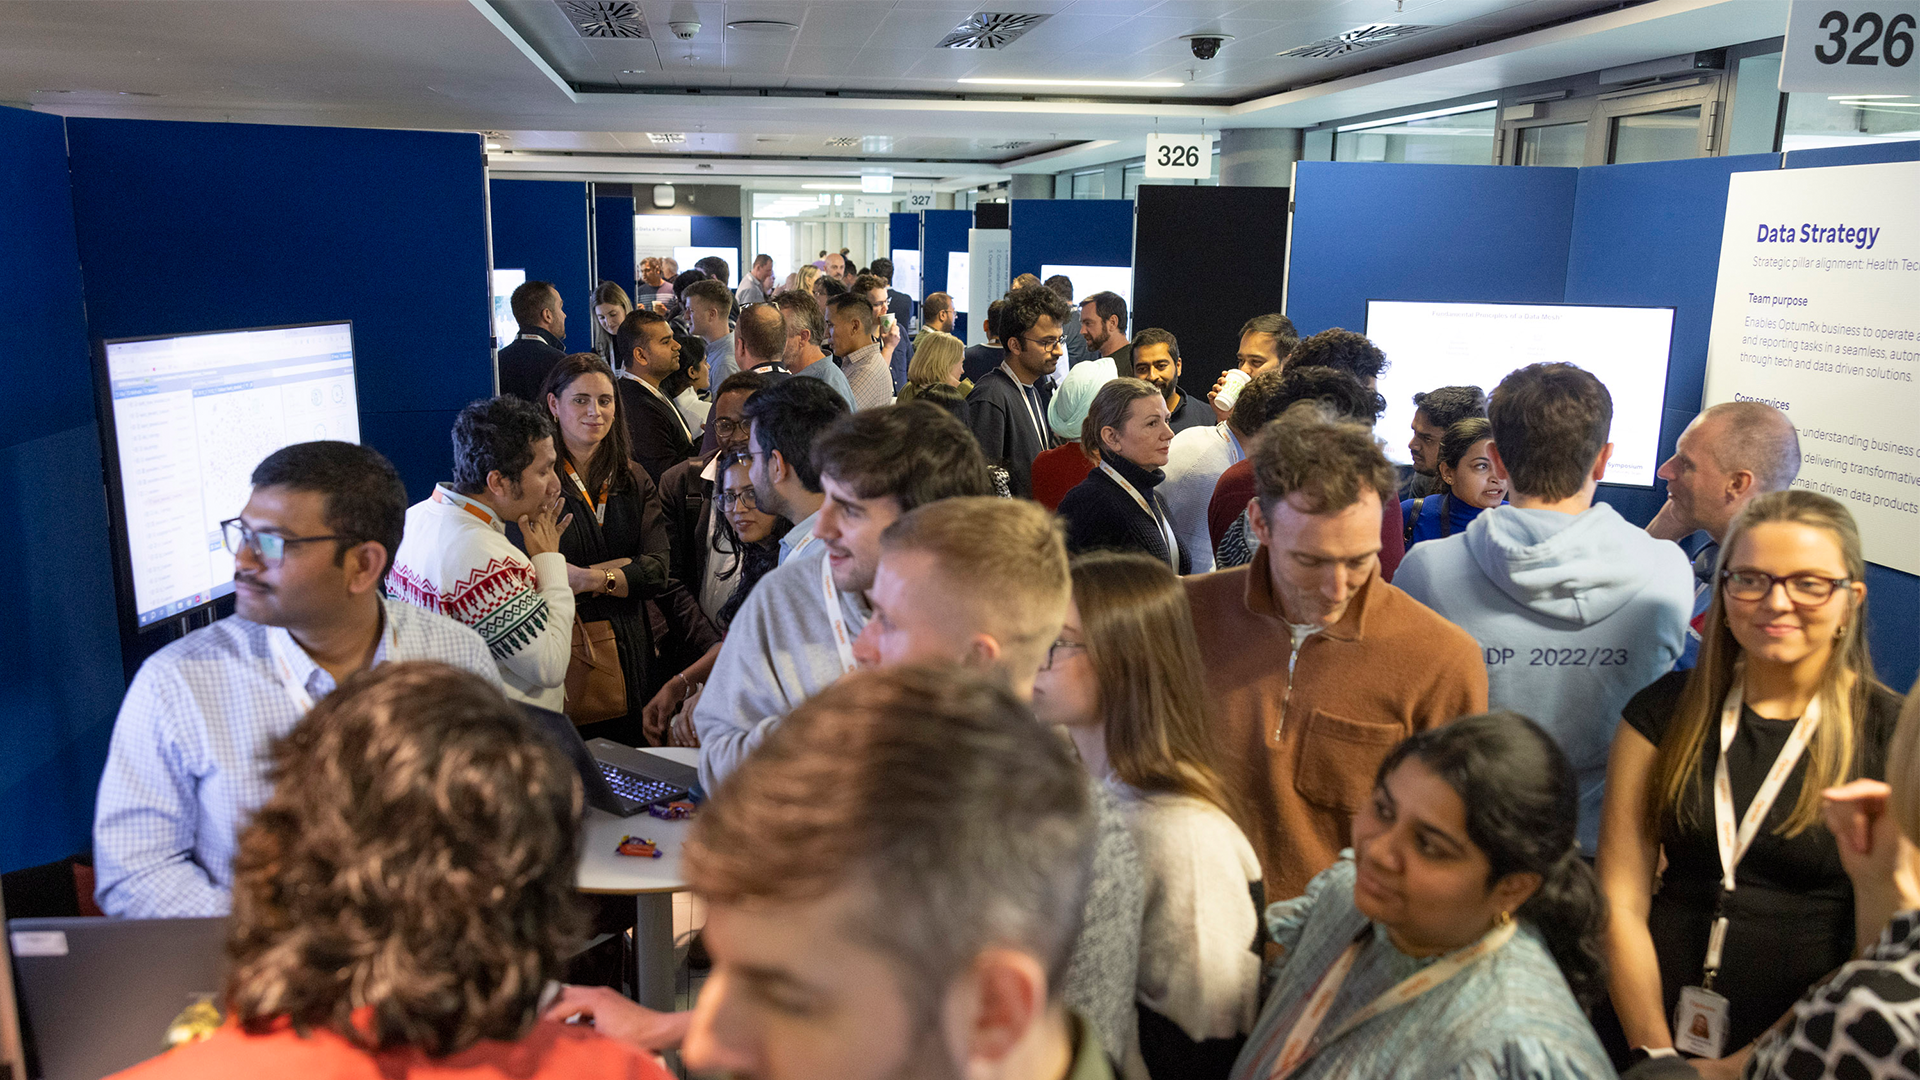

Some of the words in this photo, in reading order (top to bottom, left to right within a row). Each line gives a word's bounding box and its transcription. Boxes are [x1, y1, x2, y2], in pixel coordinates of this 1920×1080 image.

[1814, 10, 1917, 67] 326
[1157, 145, 1199, 167] 326
[911, 195, 931, 206] 327
[1757, 224, 1796, 243] Data
[1799, 223, 1880, 250] Strategy
[1752, 255, 1791, 271] Strategic
[1792, 257, 1814, 271] pillar
[1815, 256, 1865, 272] alignment:
[1866, 257, 1899, 271] Health
[1749, 292, 1771, 305] Team
[1772, 295, 1809, 308] purpose
[1432, 310, 1474, 318] Fundamental
[1475, 311, 1508, 320] Principles
[1744, 315, 1777, 330] Enables
[1778, 318, 1820, 333] OptumRx
[1821, 322, 1861, 337] business
[1862, 326, 1873, 338] to
[1874, 328, 1915, 342] operate
[1742, 334, 1758, 346] and
[1759, 337, 1799, 352] reporting
[1800, 340, 1823, 353] tasks
[1824, 341, 1833, 353] in
[1834, 344, 1841, 354] a
[1841, 344, 1888, 360] seamless,
[1740, 352, 1773, 368] through
[1774, 355, 1794, 368] tech
[1794, 358, 1811, 370] and
[1812, 359, 1833, 373] data
[1834, 362, 1864, 377] driven
[1865, 366, 1913, 383] solutions.
[1734, 392, 1754, 403] Core
[1755, 397, 1790, 411] services
[1802, 428, 1869, 452] understanding
[1870, 437, 1914, 457] business
[1607, 461, 1644, 470] Symposium
[1803, 452, 1848, 474] delivering
[1849, 461, 1920, 487] transformative
[1790, 477, 1818, 489] omain
[1819, 481, 1848, 498] driven
[1849, 488, 1872, 503] data
[1872, 495, 1919, 514] products
[835, 619, 846, 645] Optum
[1486, 647, 1515, 665] DP
[1529, 647, 1628, 667] 2022/23
